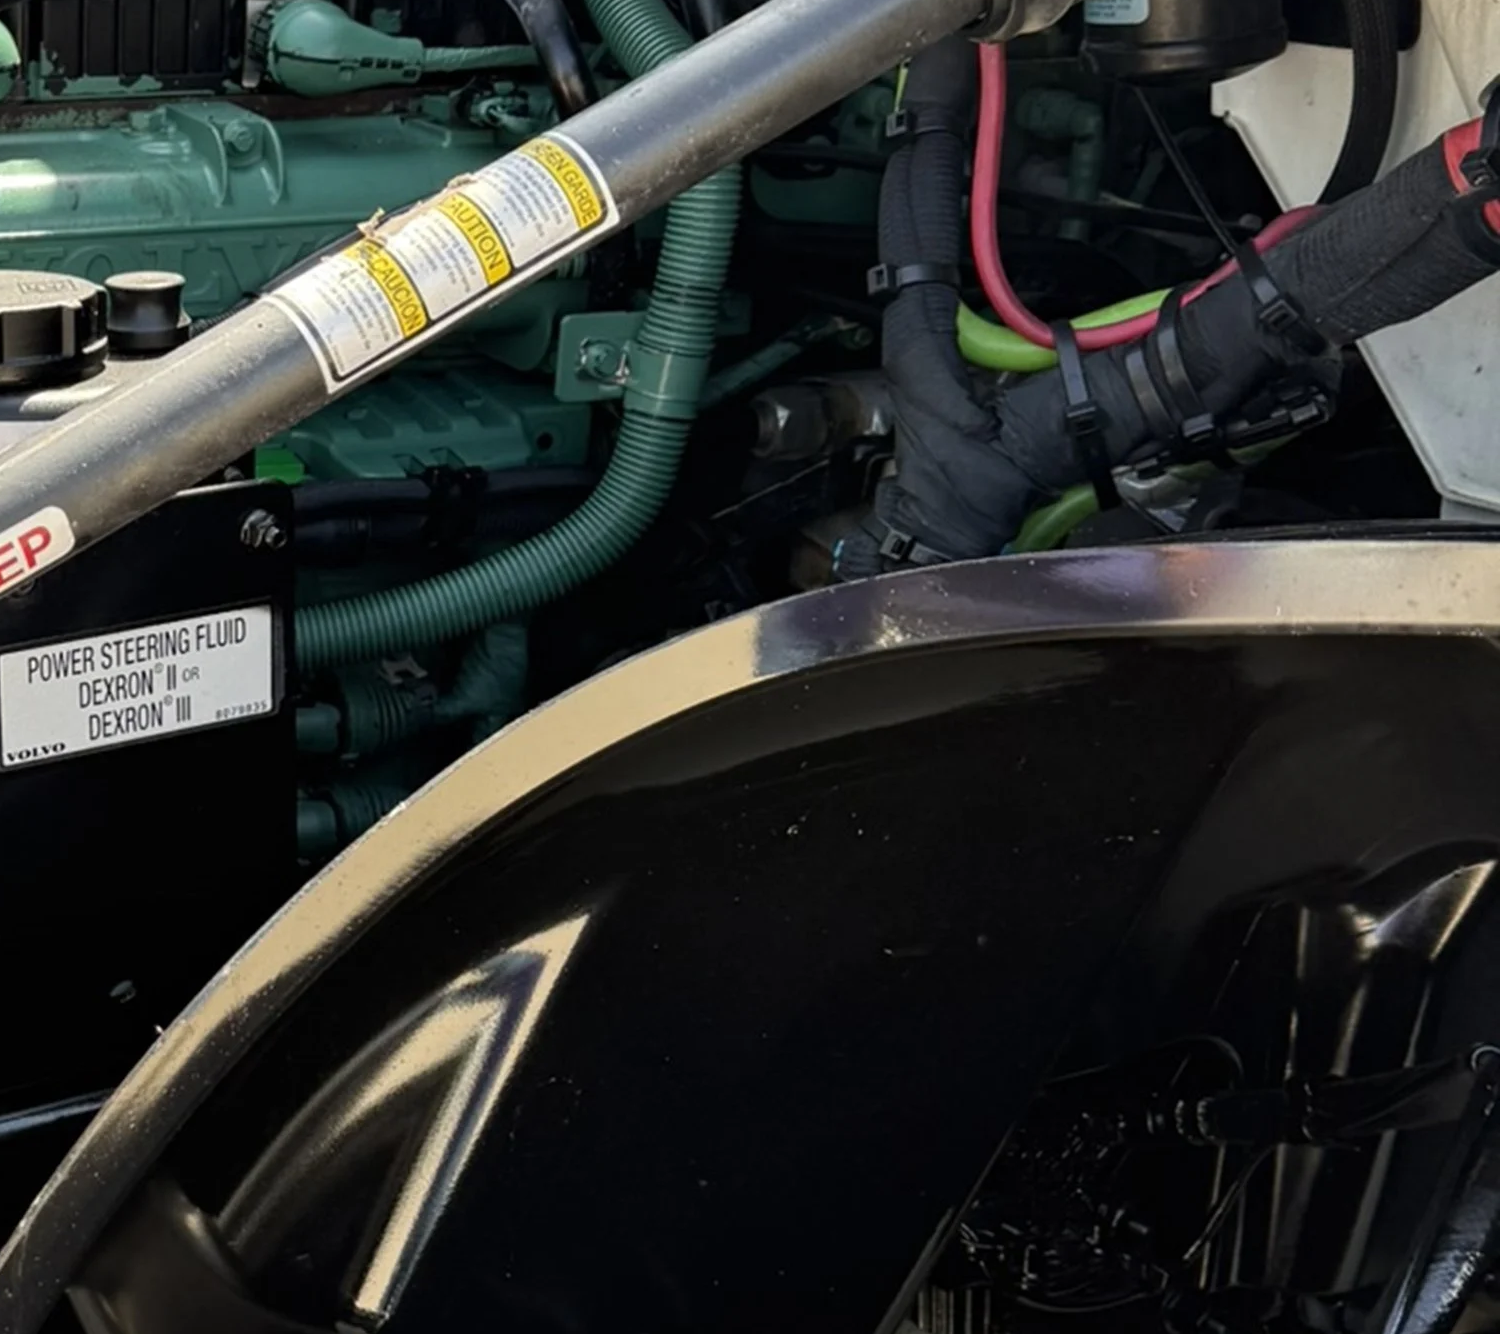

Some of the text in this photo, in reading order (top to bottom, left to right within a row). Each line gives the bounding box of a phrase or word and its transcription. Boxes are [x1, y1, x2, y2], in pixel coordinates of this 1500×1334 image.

[562, 170, 600, 223] GARDE
[28, 617, 247, 683] POWER STEERING FLUID
[166, 664, 178, 691] II
[182, 666, 201, 683] OR
[176, 695, 192, 723] III
[6, 742, 66, 763] VOLVO
